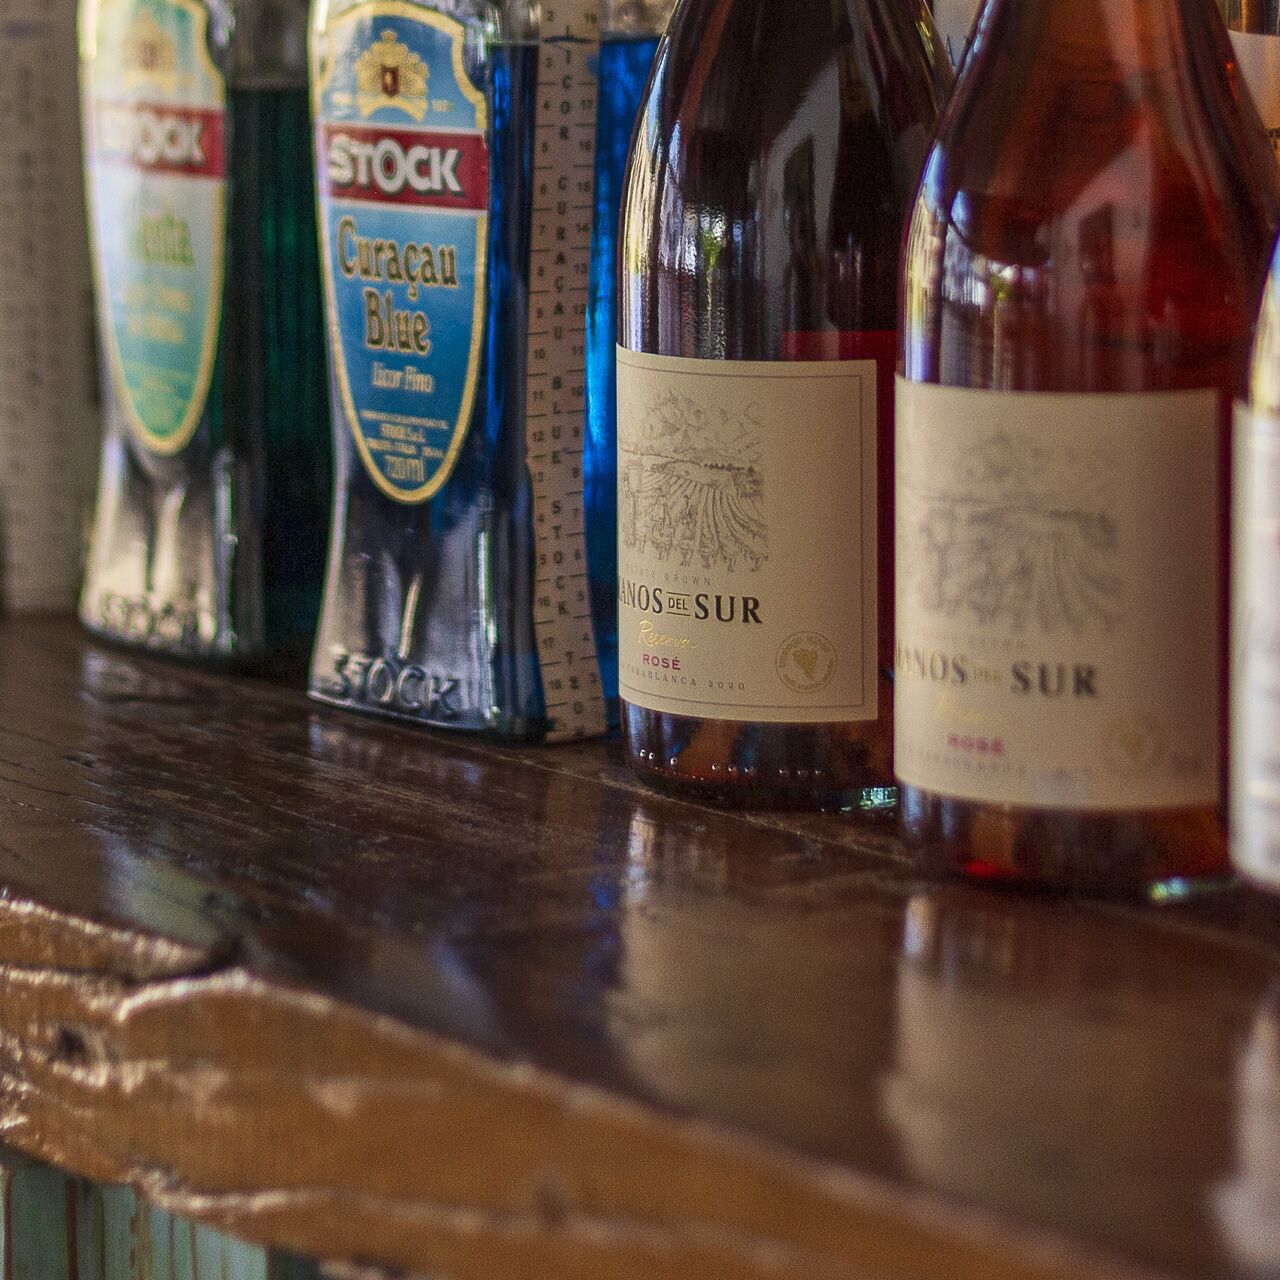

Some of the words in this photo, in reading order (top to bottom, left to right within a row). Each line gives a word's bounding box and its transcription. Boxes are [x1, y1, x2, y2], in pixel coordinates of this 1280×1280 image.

[328, 133, 463, 196] STOCK
[337, 215, 458, 300] Curaçau
[363, 287, 431, 356] Blue
[668, 597, 689, 612] DEL
[694, 593, 763, 624] SUR
[642, 653, 682, 671] ROSÉ
[1010, 660, 1096, 699] SUR
[708, 679, 746, 691] 2020
